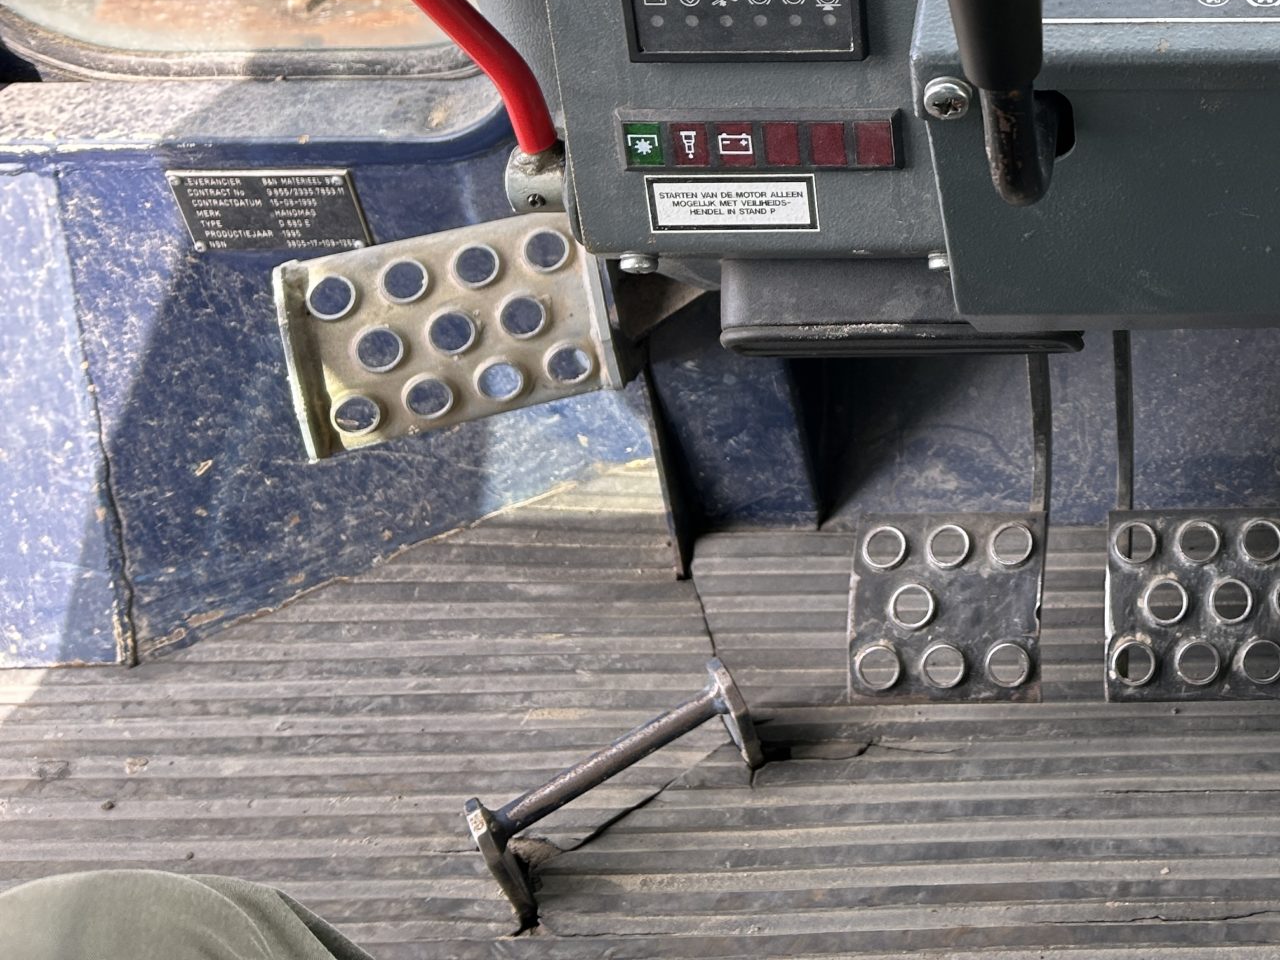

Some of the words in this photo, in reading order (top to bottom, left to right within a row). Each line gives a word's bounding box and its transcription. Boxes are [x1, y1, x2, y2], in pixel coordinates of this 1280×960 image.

[187, 188, 231, 197] CONTRACT
[659, 191, 698, 199] STARTEN
[701, 191, 718, 199] VAN
[720, 191, 732, 199] DE
[735, 191, 767, 199] MOTOR
[191, 199, 262, 207] CONTRACTDATUM
[672, 200, 717, 208] MOGELIJK
[196, 209, 221, 217] MERK
[689, 208, 724, 216] HENDEL
[770, 207, 776, 215] P
[200, 219, 223, 228] TYPE
[204, 229, 274, 238] PRODUCTIEJAAR
